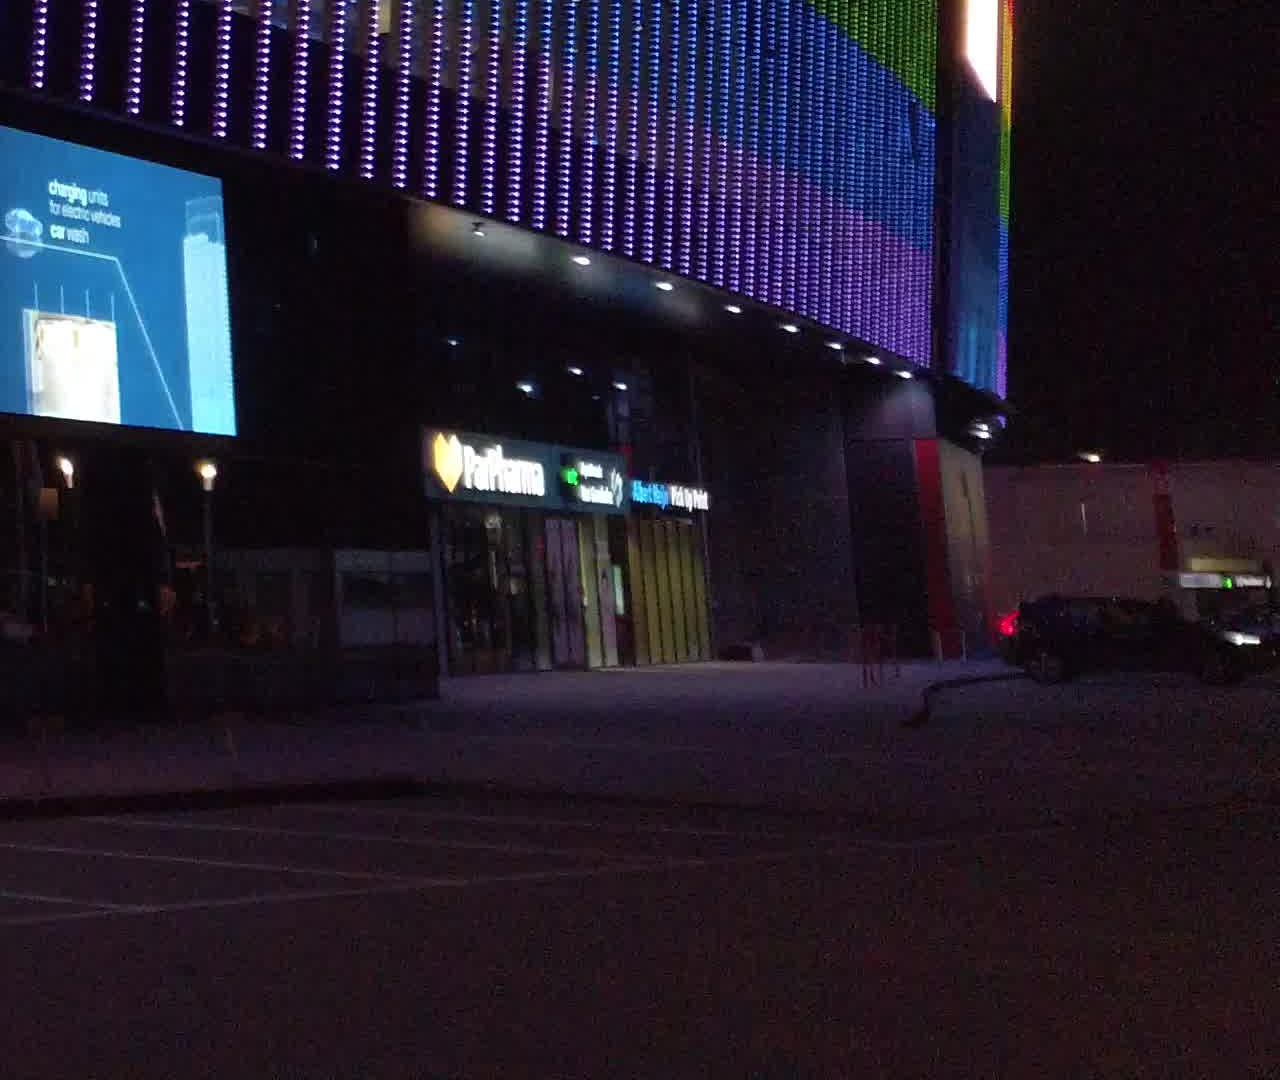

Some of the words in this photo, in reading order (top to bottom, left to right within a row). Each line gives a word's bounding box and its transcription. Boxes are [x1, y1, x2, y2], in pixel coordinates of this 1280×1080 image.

[48, 179, 88, 207] charging
[50, 199, 61, 216] for
[91, 209, 121, 228] vehicles
[50, 224, 65, 239] car
[66, 228, 89, 244] wash
